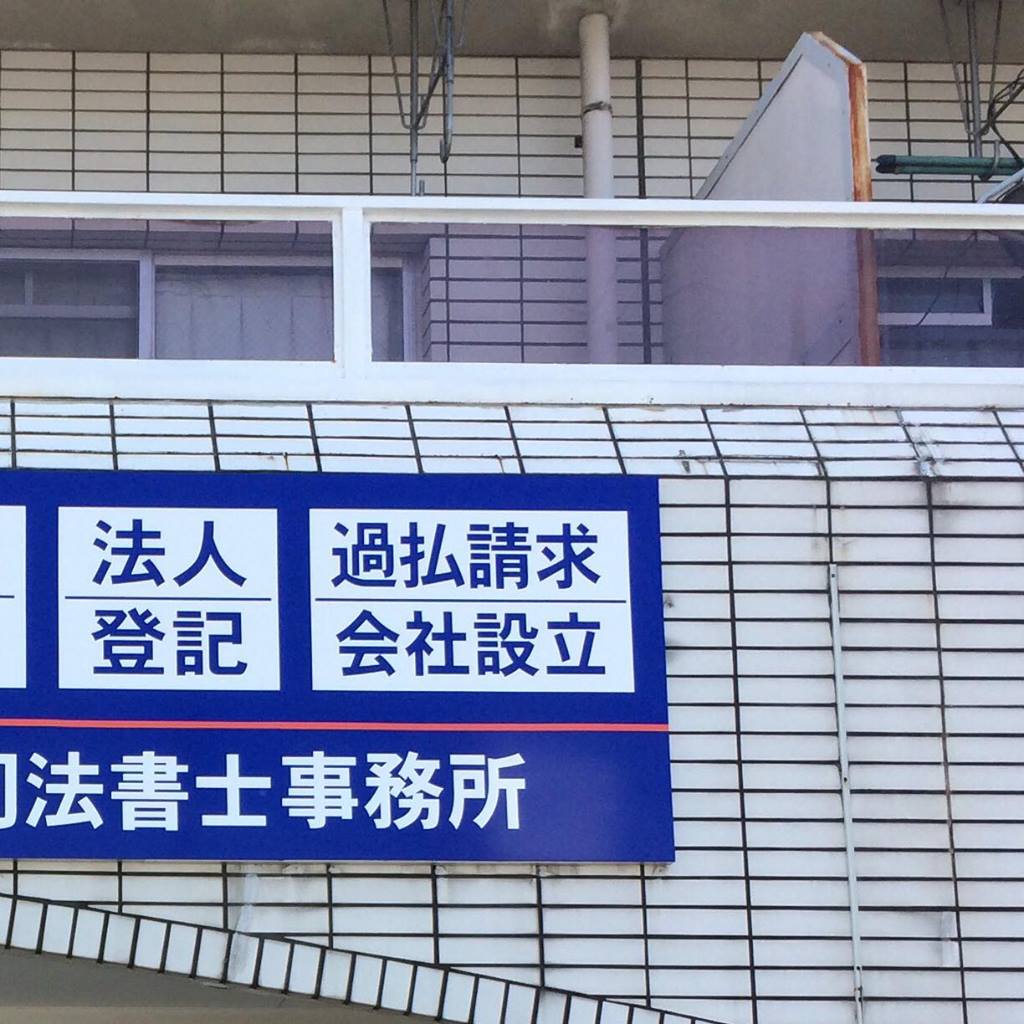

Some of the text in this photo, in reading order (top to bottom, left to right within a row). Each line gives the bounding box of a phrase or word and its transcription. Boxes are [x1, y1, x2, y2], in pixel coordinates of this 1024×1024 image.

[92, 518, 247, 587] 法人
[331, 521, 602, 589] 過払請求
[92, 607, 248, 677] 登記
[337, 609, 606, 677] 会社設立
